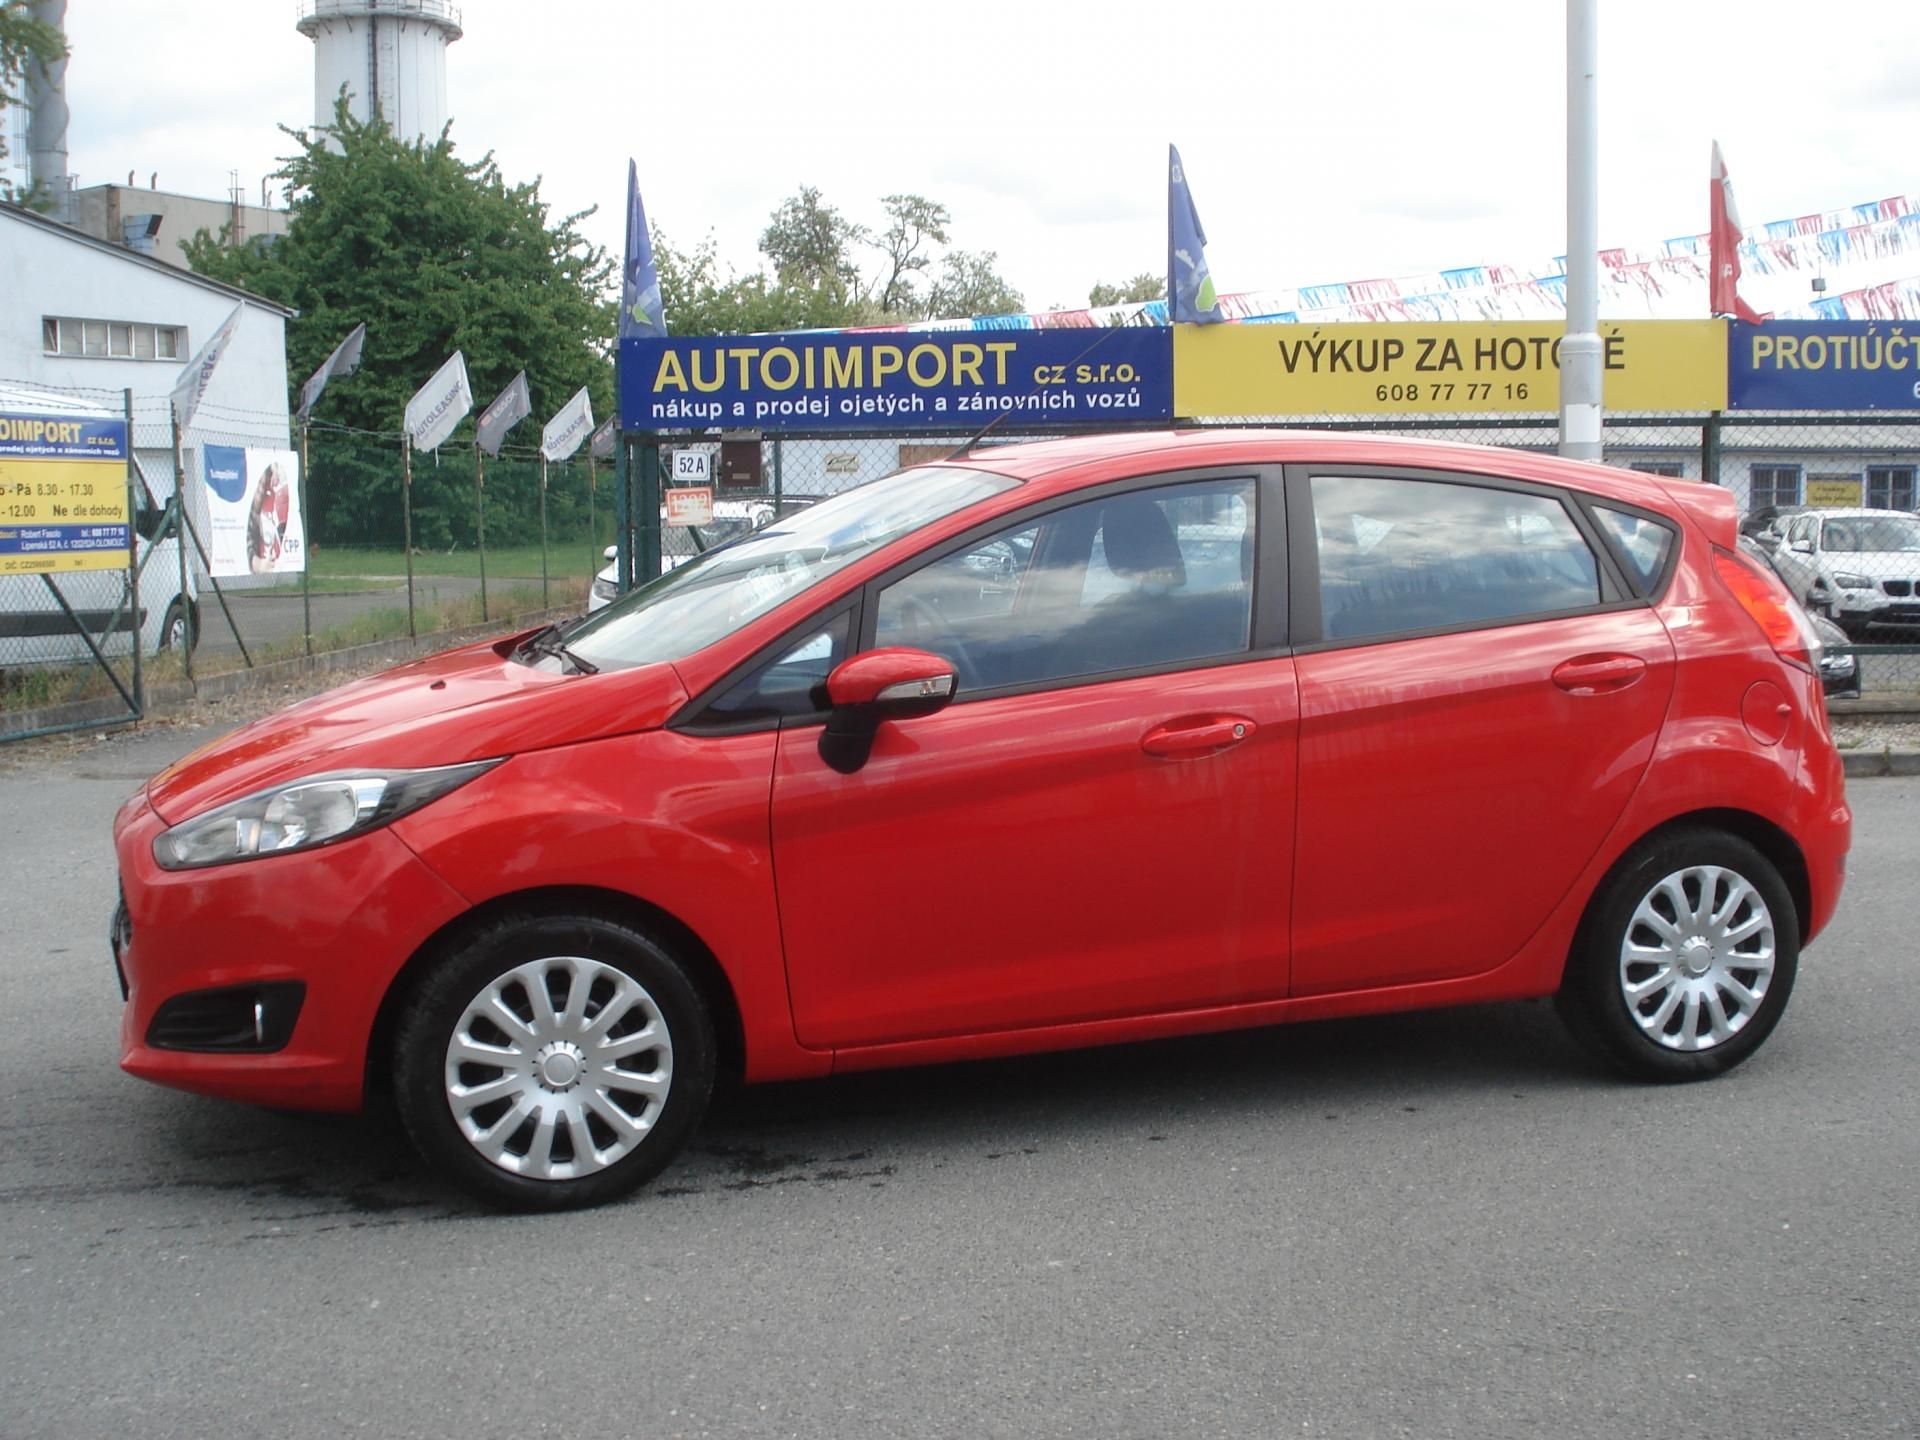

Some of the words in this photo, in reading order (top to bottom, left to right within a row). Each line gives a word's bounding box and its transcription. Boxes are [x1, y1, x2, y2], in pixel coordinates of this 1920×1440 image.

[1279, 330, 1404, 373] VÝKUP
[1415, 337, 1463, 371] ZA
[1475, 328, 1625, 370] HOTÉ
[652, 342, 1017, 393] AUTOIMPORT
[1033, 365, 1066, 384] cz
[1076, 363, 1141, 383] s.r.o.
[652, 399, 722, 420] nákup
[733, 404, 745, 416] a
[756, 396, 830, 419] prodej
[840, 393, 924, 416] ojetých
[935, 397, 947, 411] a
[957, 390, 1075, 411] zánovních
[1085, 387, 1141, 408] vozů
[1375, 384, 1419, 401] 608
[1430, 383, 1455, 401] 77
[1467, 383, 1492, 400] 77
[1504, 383, 1529, 400] 16
[17, 483, 31, 496] Pá
[37, 483, 58, 496] 8.30
[69, 483, 94, 496] 17.30
[8, 504, 36, 517] 12.00
[53, 504, 68, 516] Ne
[73, 504, 88, 516] dle
[90, 503, 123, 519] dohody
